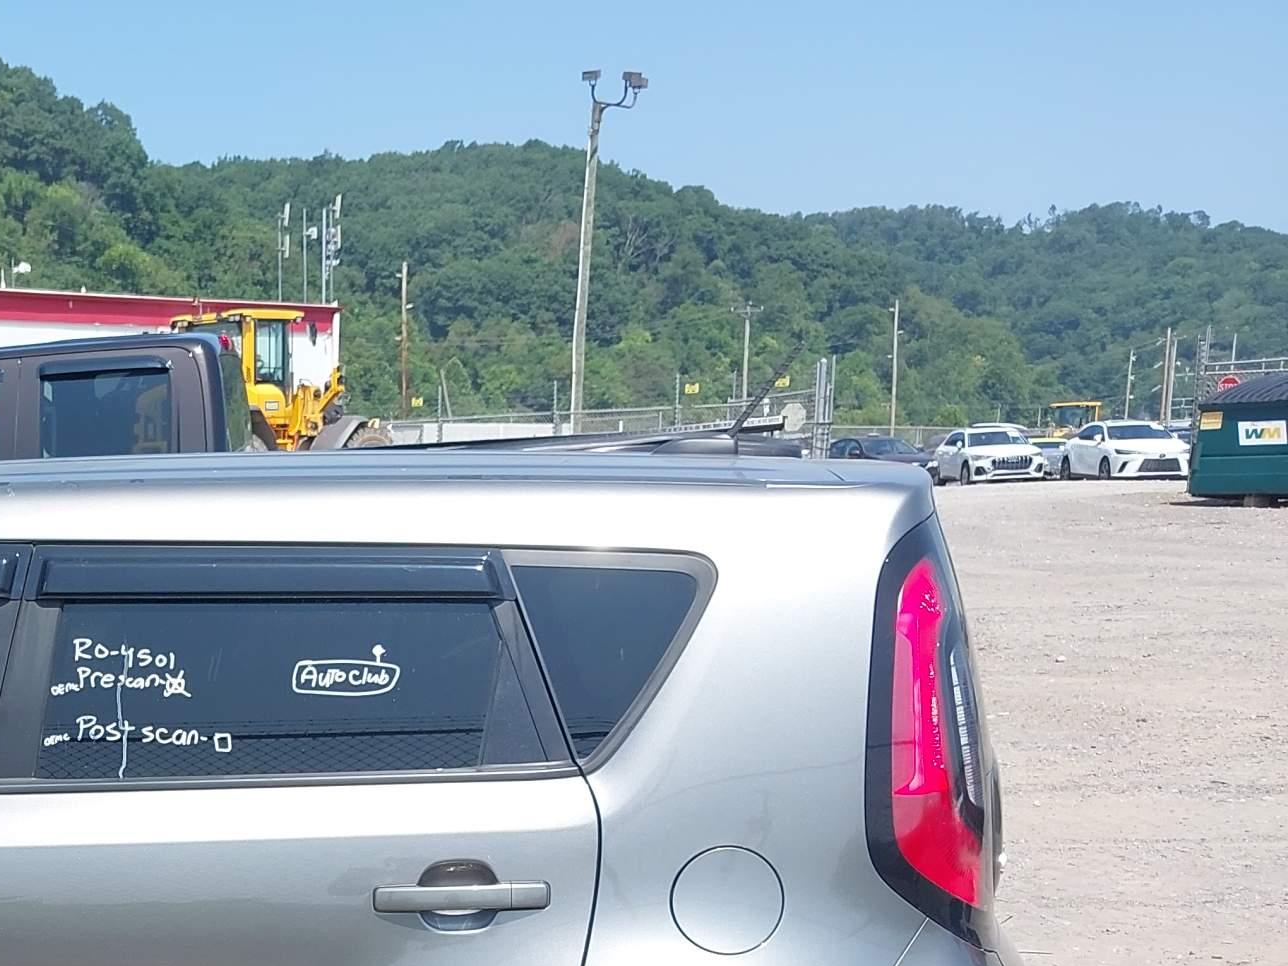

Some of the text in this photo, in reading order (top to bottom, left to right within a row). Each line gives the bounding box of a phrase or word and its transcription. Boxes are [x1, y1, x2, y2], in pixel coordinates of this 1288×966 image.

[1219, 383, 1238, 391] STO
[1245, 428, 1281, 440] WM
[76, 715, 135, 741] Post
